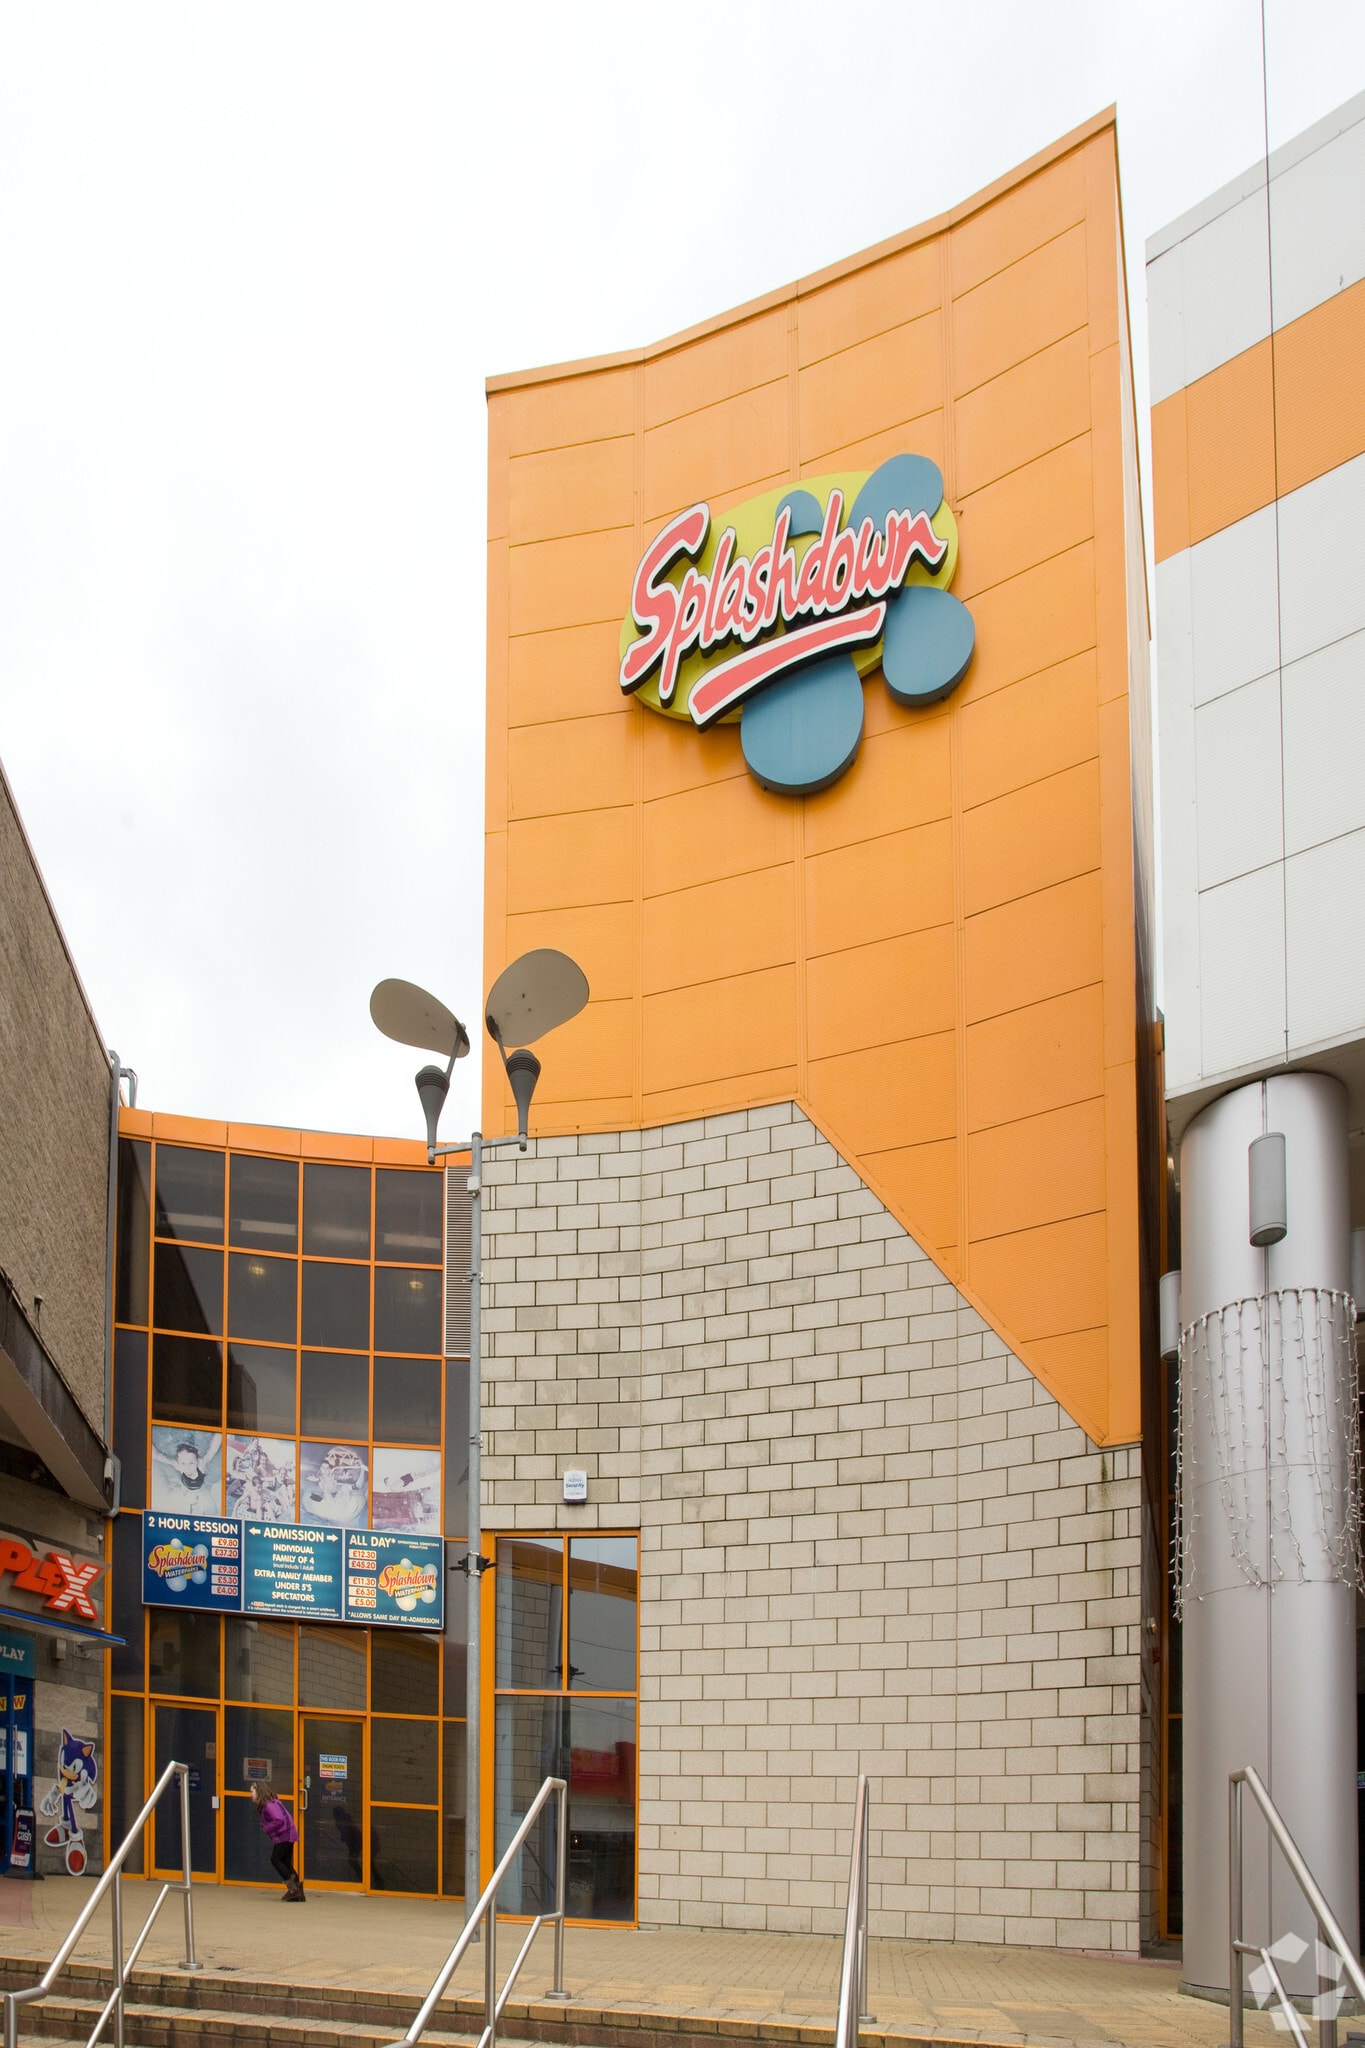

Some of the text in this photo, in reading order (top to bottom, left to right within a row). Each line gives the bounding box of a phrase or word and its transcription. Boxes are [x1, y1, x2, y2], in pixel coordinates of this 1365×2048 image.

[619, 488, 948, 702] Splashdown
[148, 1517, 238, 1534] 2 HOUR SESSION
[263, 1527, 324, 1542] ADMISSION
[218, 1539, 238, 1547] £9.80
[349, 1535, 367, 1546] ALL
[215, 1549, 238, 1557] £37.20
[273, 1543, 314, 1554] INDIVIDUAL
[352, 1550, 376, 1558] £12.30
[148, 1545, 206, 1577] Splashdown
[272, 1554, 296, 1563] FAMILY
[298, 1556, 307, 1564] OF
[351, 1561, 376, 1569] £45.20
[217, 1566, 238, 1574] £9.30
[217, 1576, 238, 1584] £5.30
[254, 1569, 333, 1583] EXTRA FAMILY MEMBER
[275, 1581, 300, 1590] UNDER
[352, 1577, 376, 1586] £11.30
[378, 1565, 435, 1597] Splashdown
[217, 1587, 238, 1595] £4.00
[355, 1588, 376, 1596] £6.30
[271, 1591, 315, 1602] SPECTATORS
[354, 1598, 376, 1606] £5.00
[400, 1615, 440, 1624] RE-ADMISSION
[17, 1829, 32, 1842] cash
